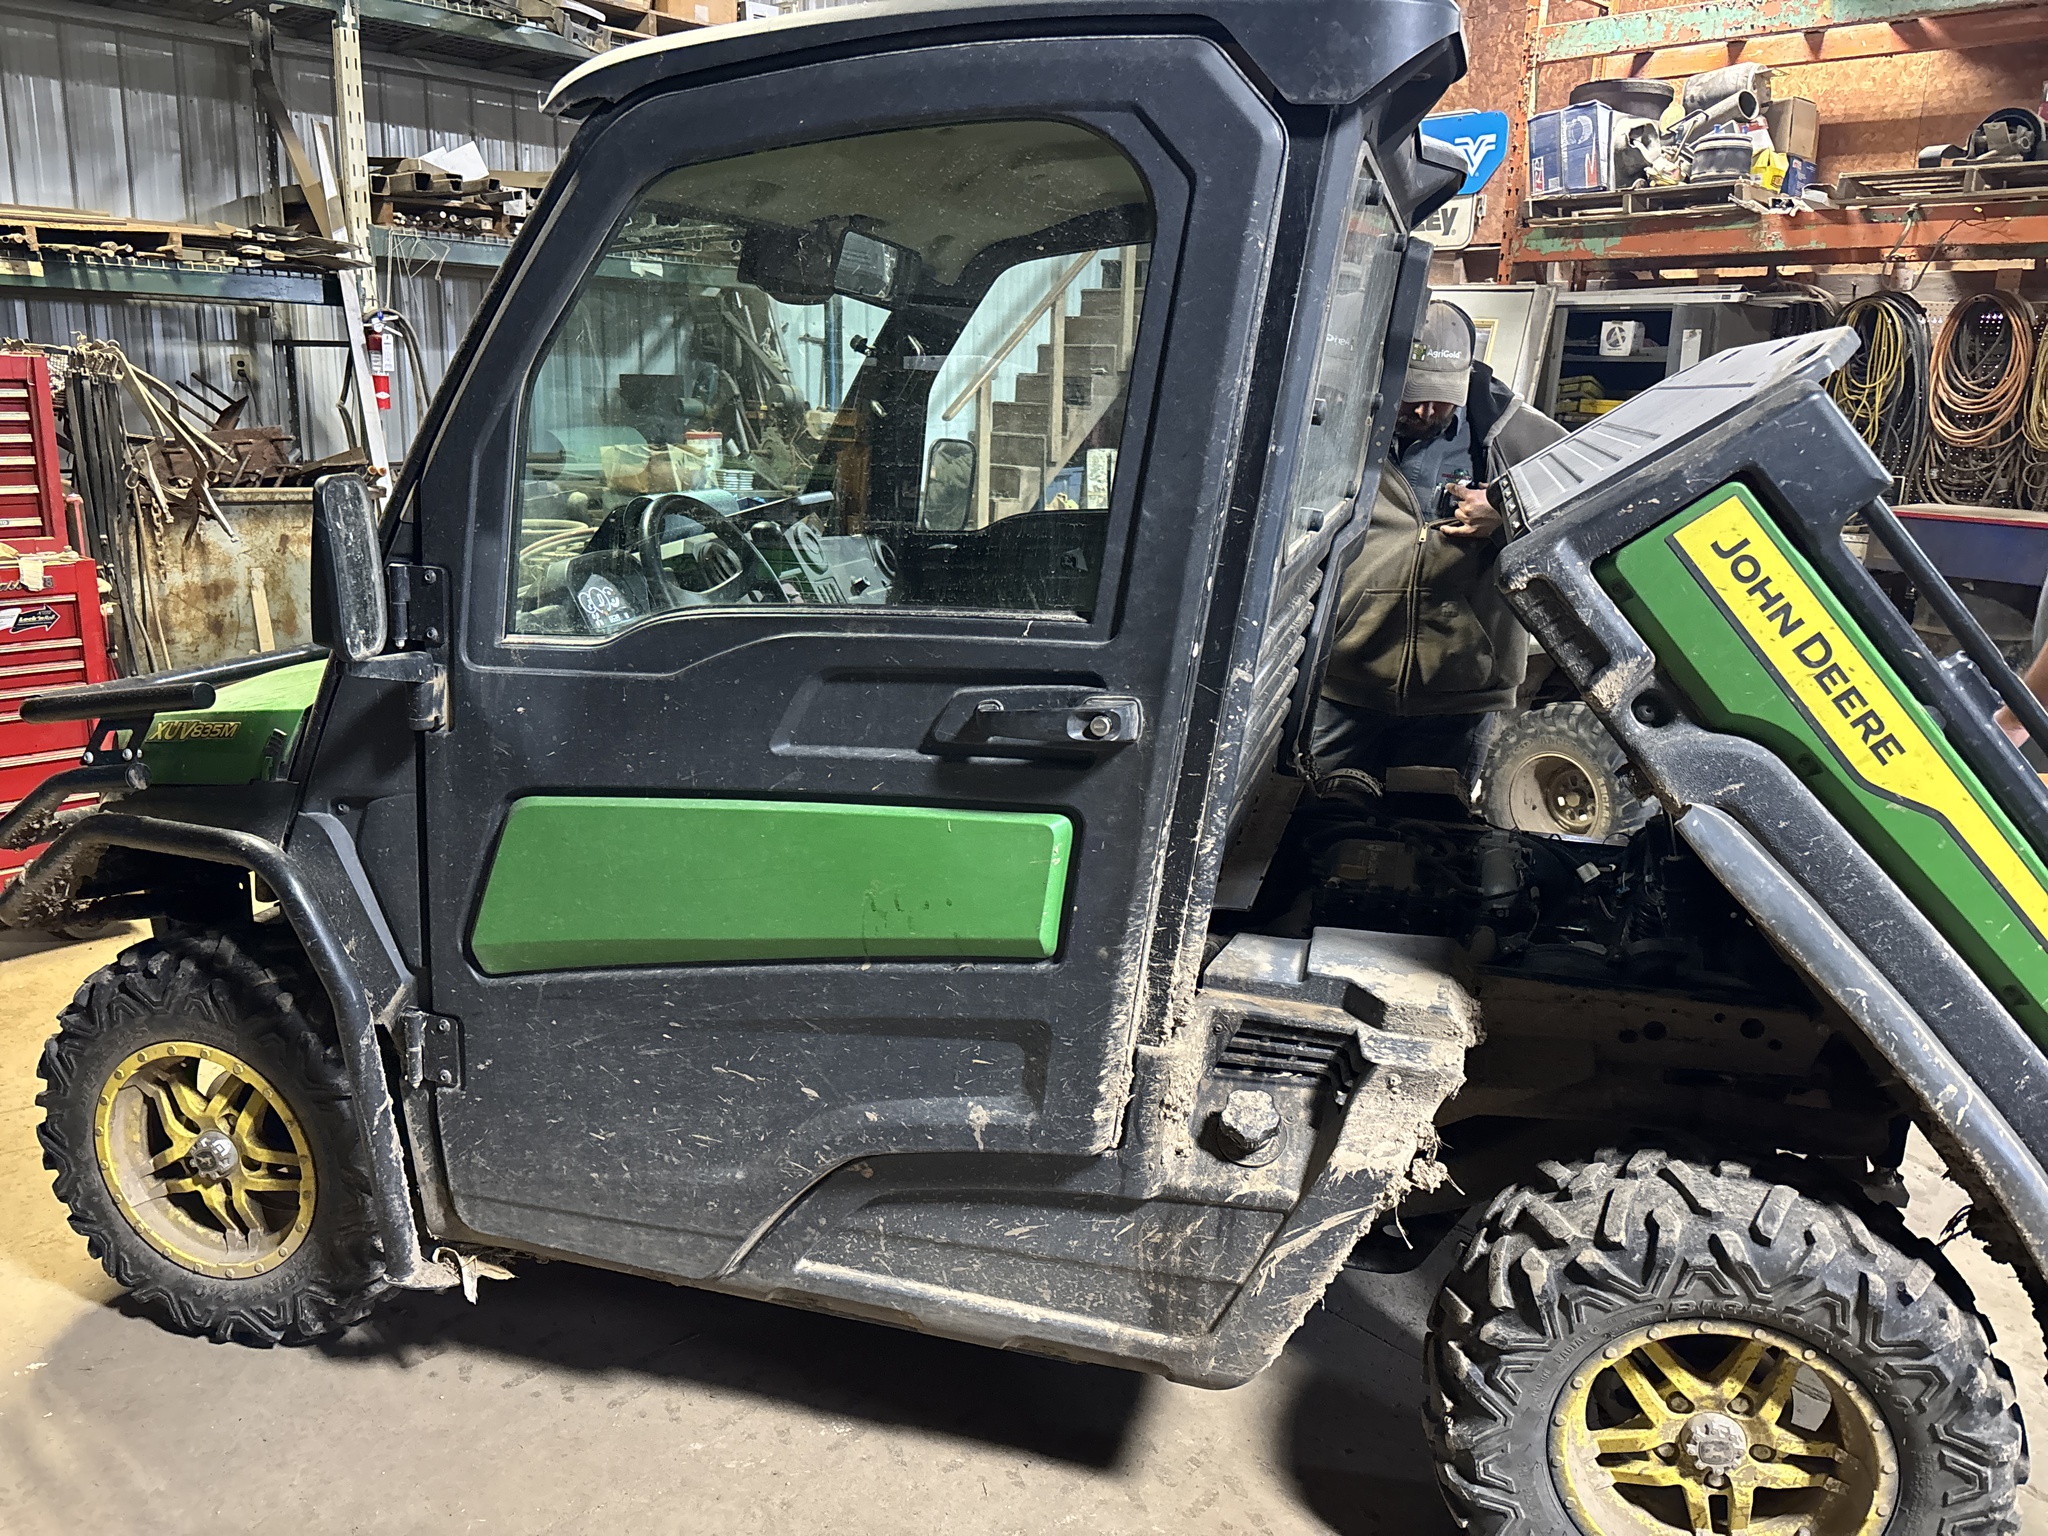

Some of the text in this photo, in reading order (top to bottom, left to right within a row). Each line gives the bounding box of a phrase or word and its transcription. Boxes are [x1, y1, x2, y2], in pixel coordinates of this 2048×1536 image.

[1427, 348, 1461, 359] AgriGold
[1710, 537, 1906, 766] JOHN DEERE
[148, 721, 238, 739] XUV835M
[1554, 1336, 1590, 1365] RADIAL
